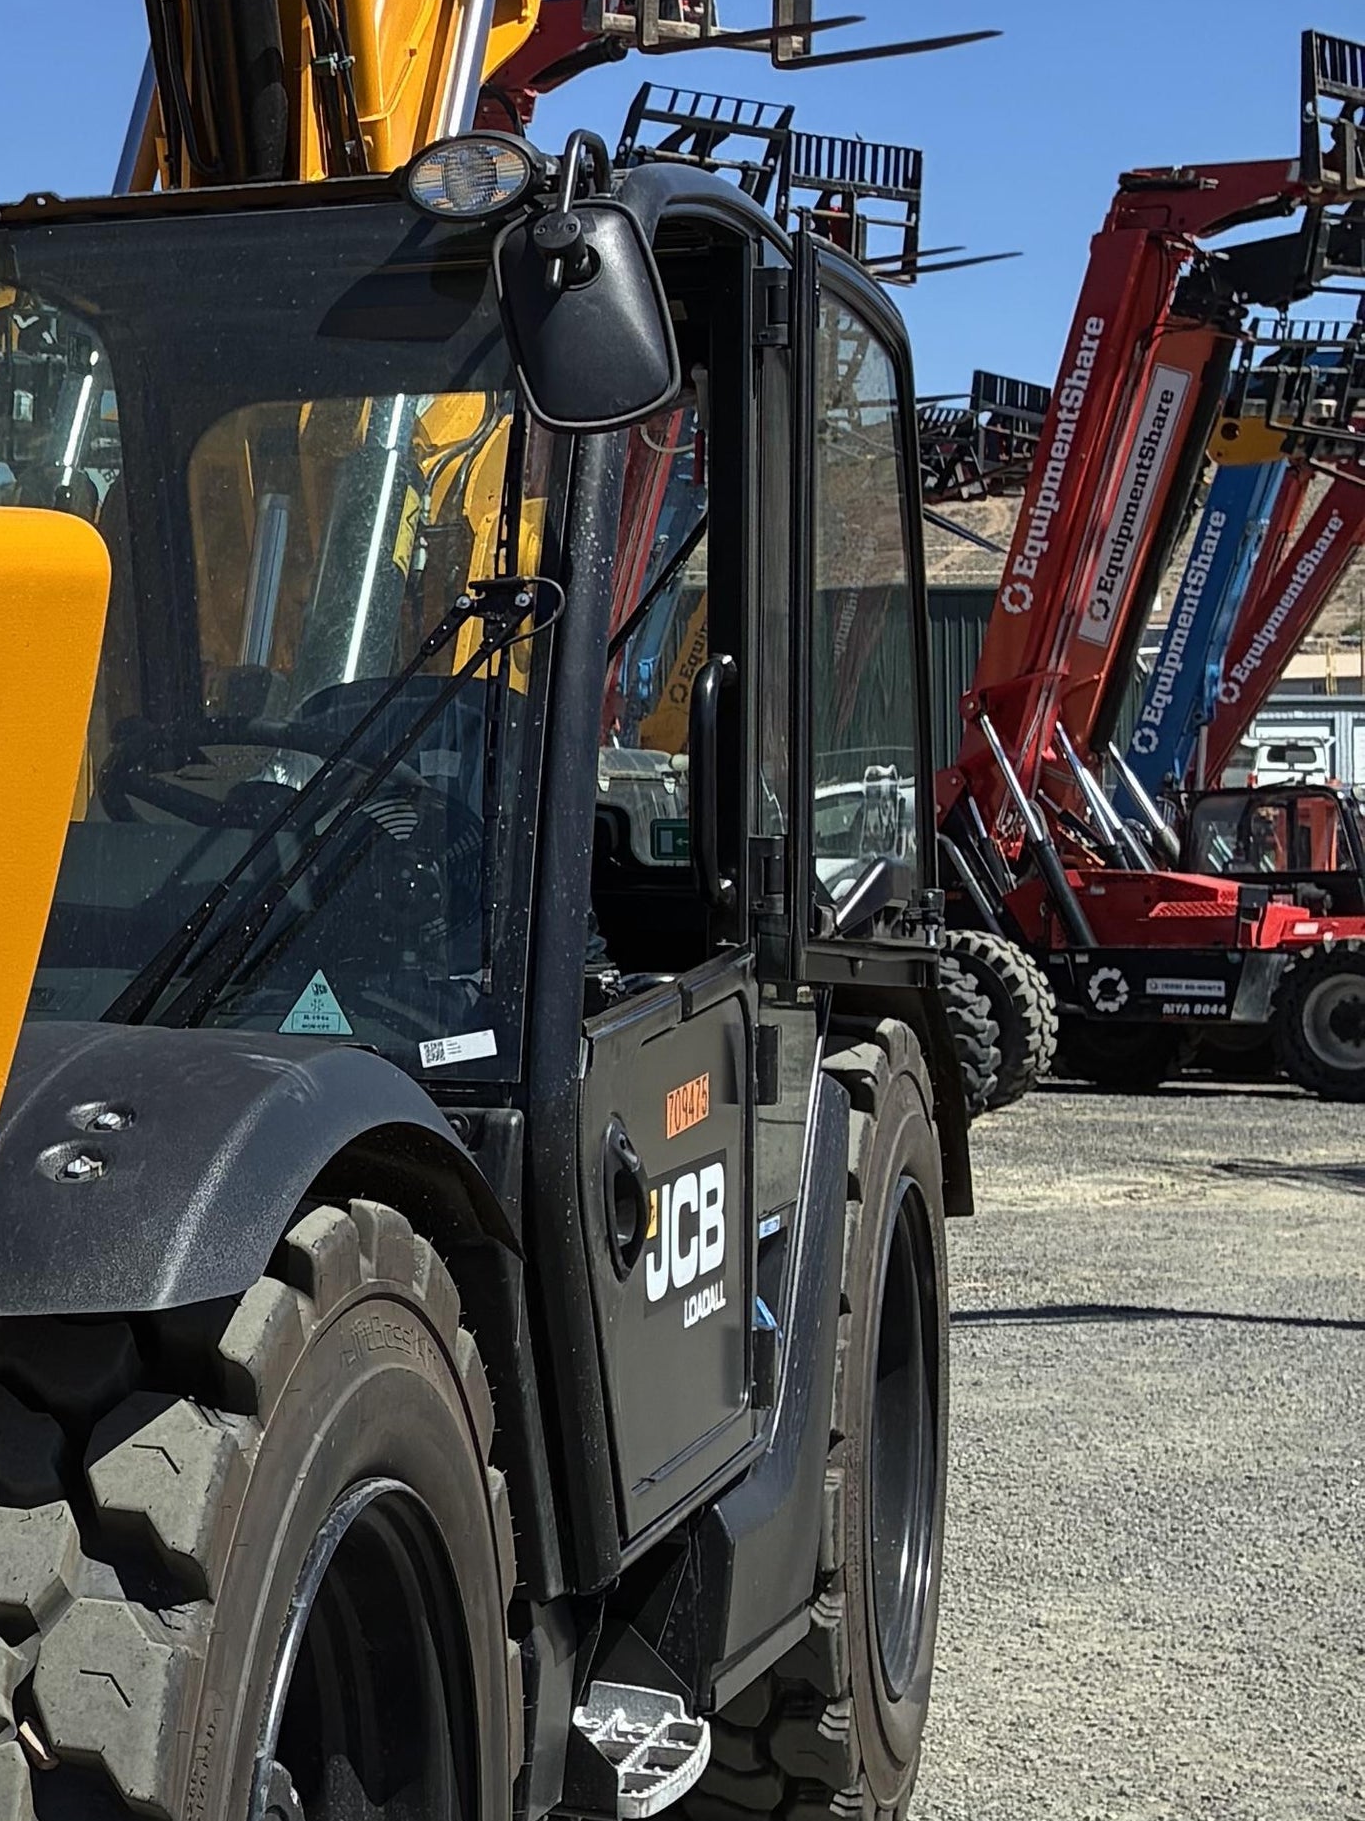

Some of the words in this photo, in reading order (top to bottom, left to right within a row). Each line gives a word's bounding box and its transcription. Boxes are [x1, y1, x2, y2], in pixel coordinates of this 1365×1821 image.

[1013, 315, 1105, 579] EquipmentShare
[1097, 388, 1175, 597] EquipmentShare
[669, 1077, 708, 1134] 709475
[646, 1162, 725, 1303] JCB
[684, 1280, 727, 1329] LOADALL
